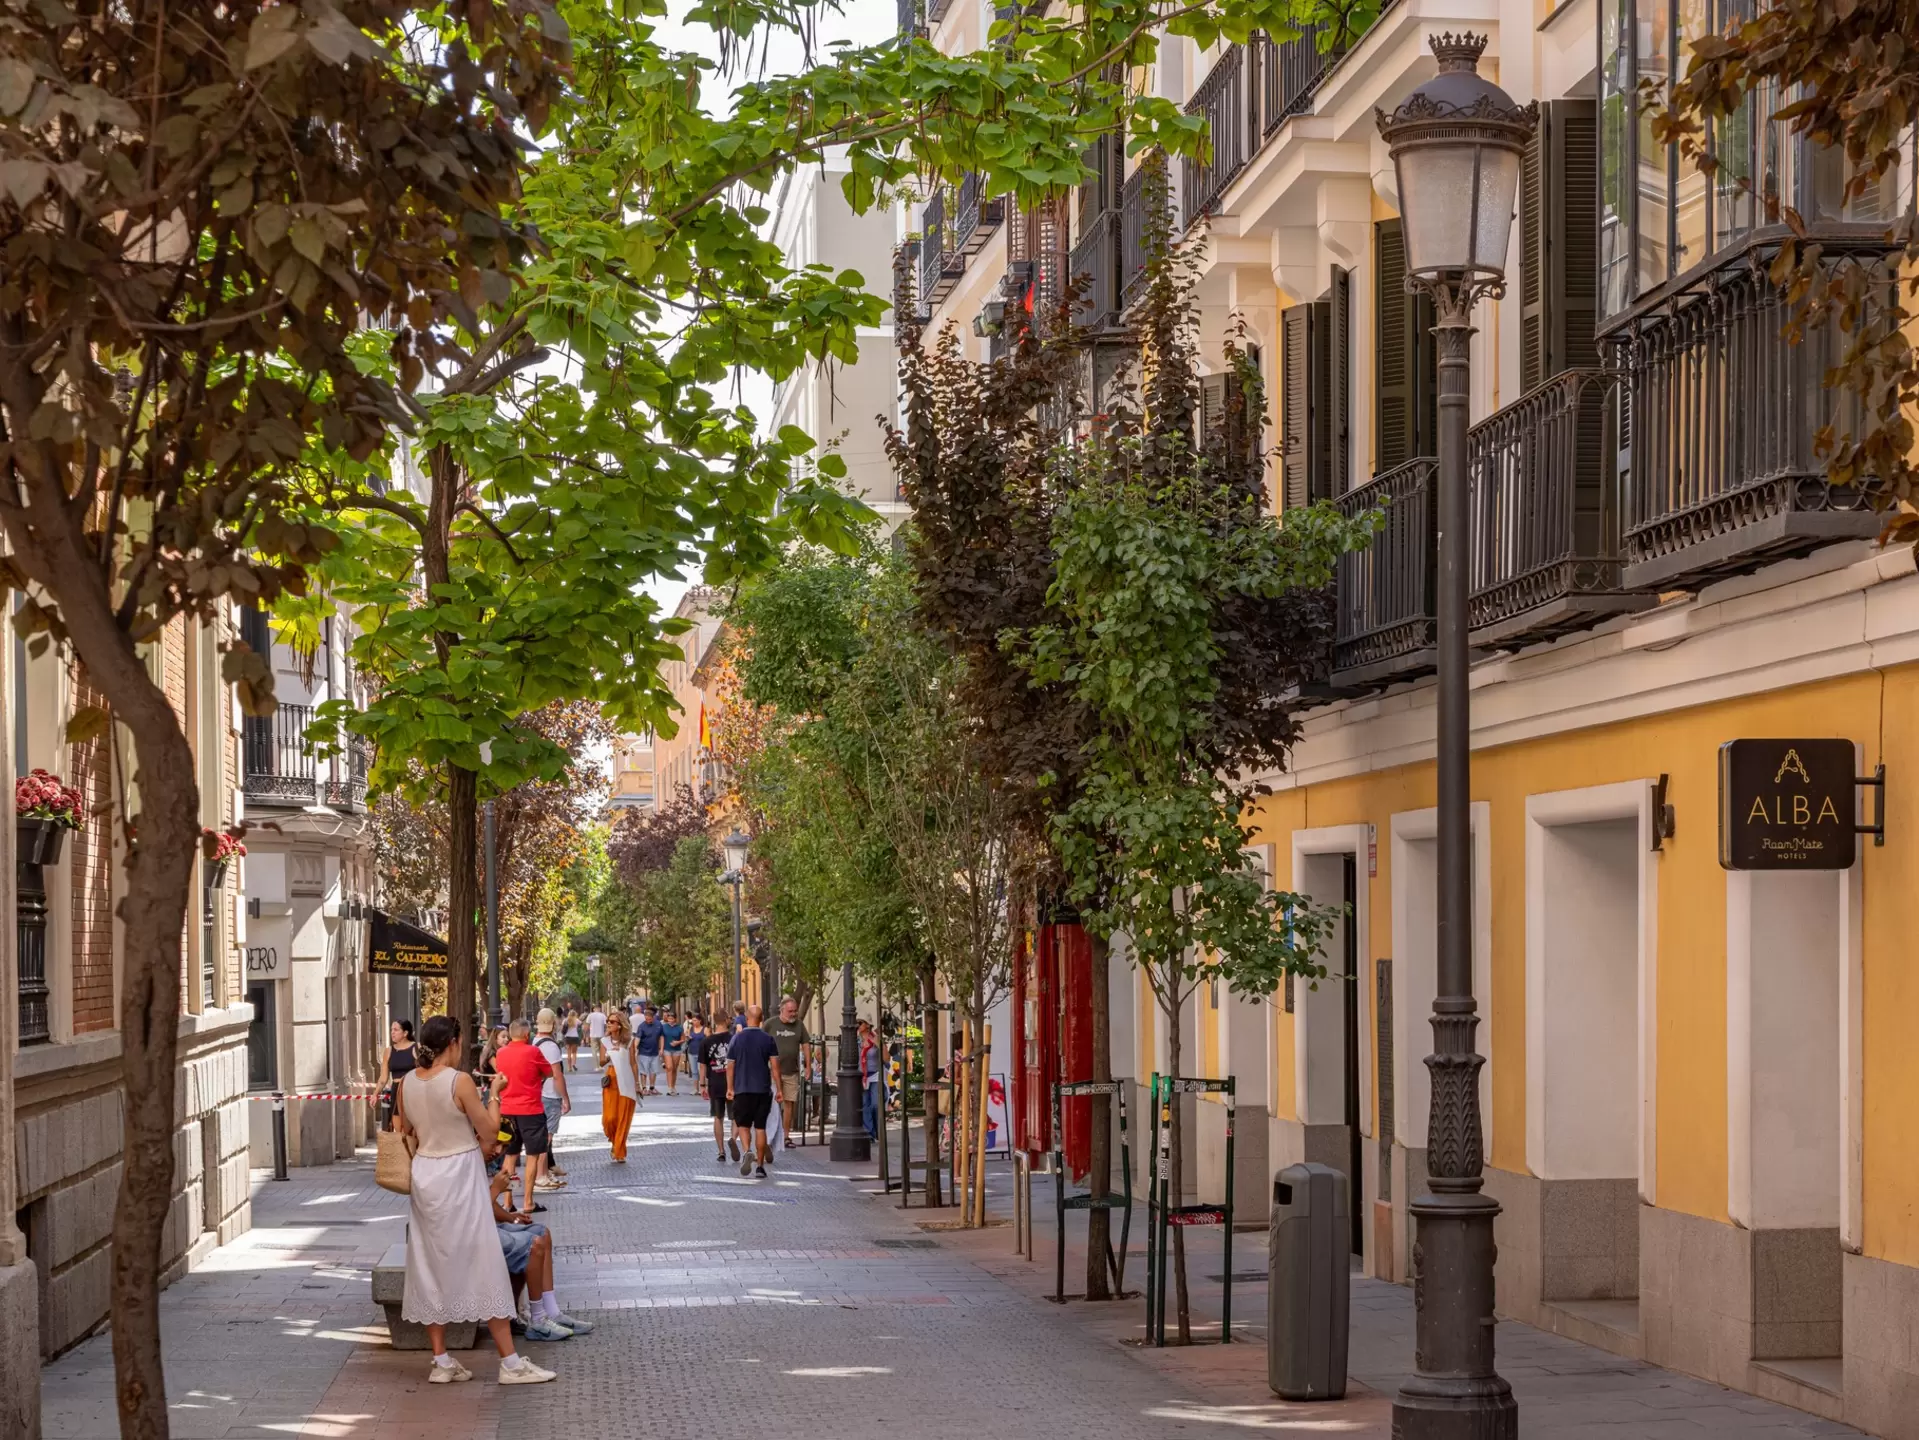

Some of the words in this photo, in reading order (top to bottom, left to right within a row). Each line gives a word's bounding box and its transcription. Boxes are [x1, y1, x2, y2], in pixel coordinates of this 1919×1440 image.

[1747, 796, 1839, 825] ALBA
[1777, 852, 1807, 860] HOTELS
[374, 951, 391, 961] EL
[396, 951, 448, 967] CALDERO
